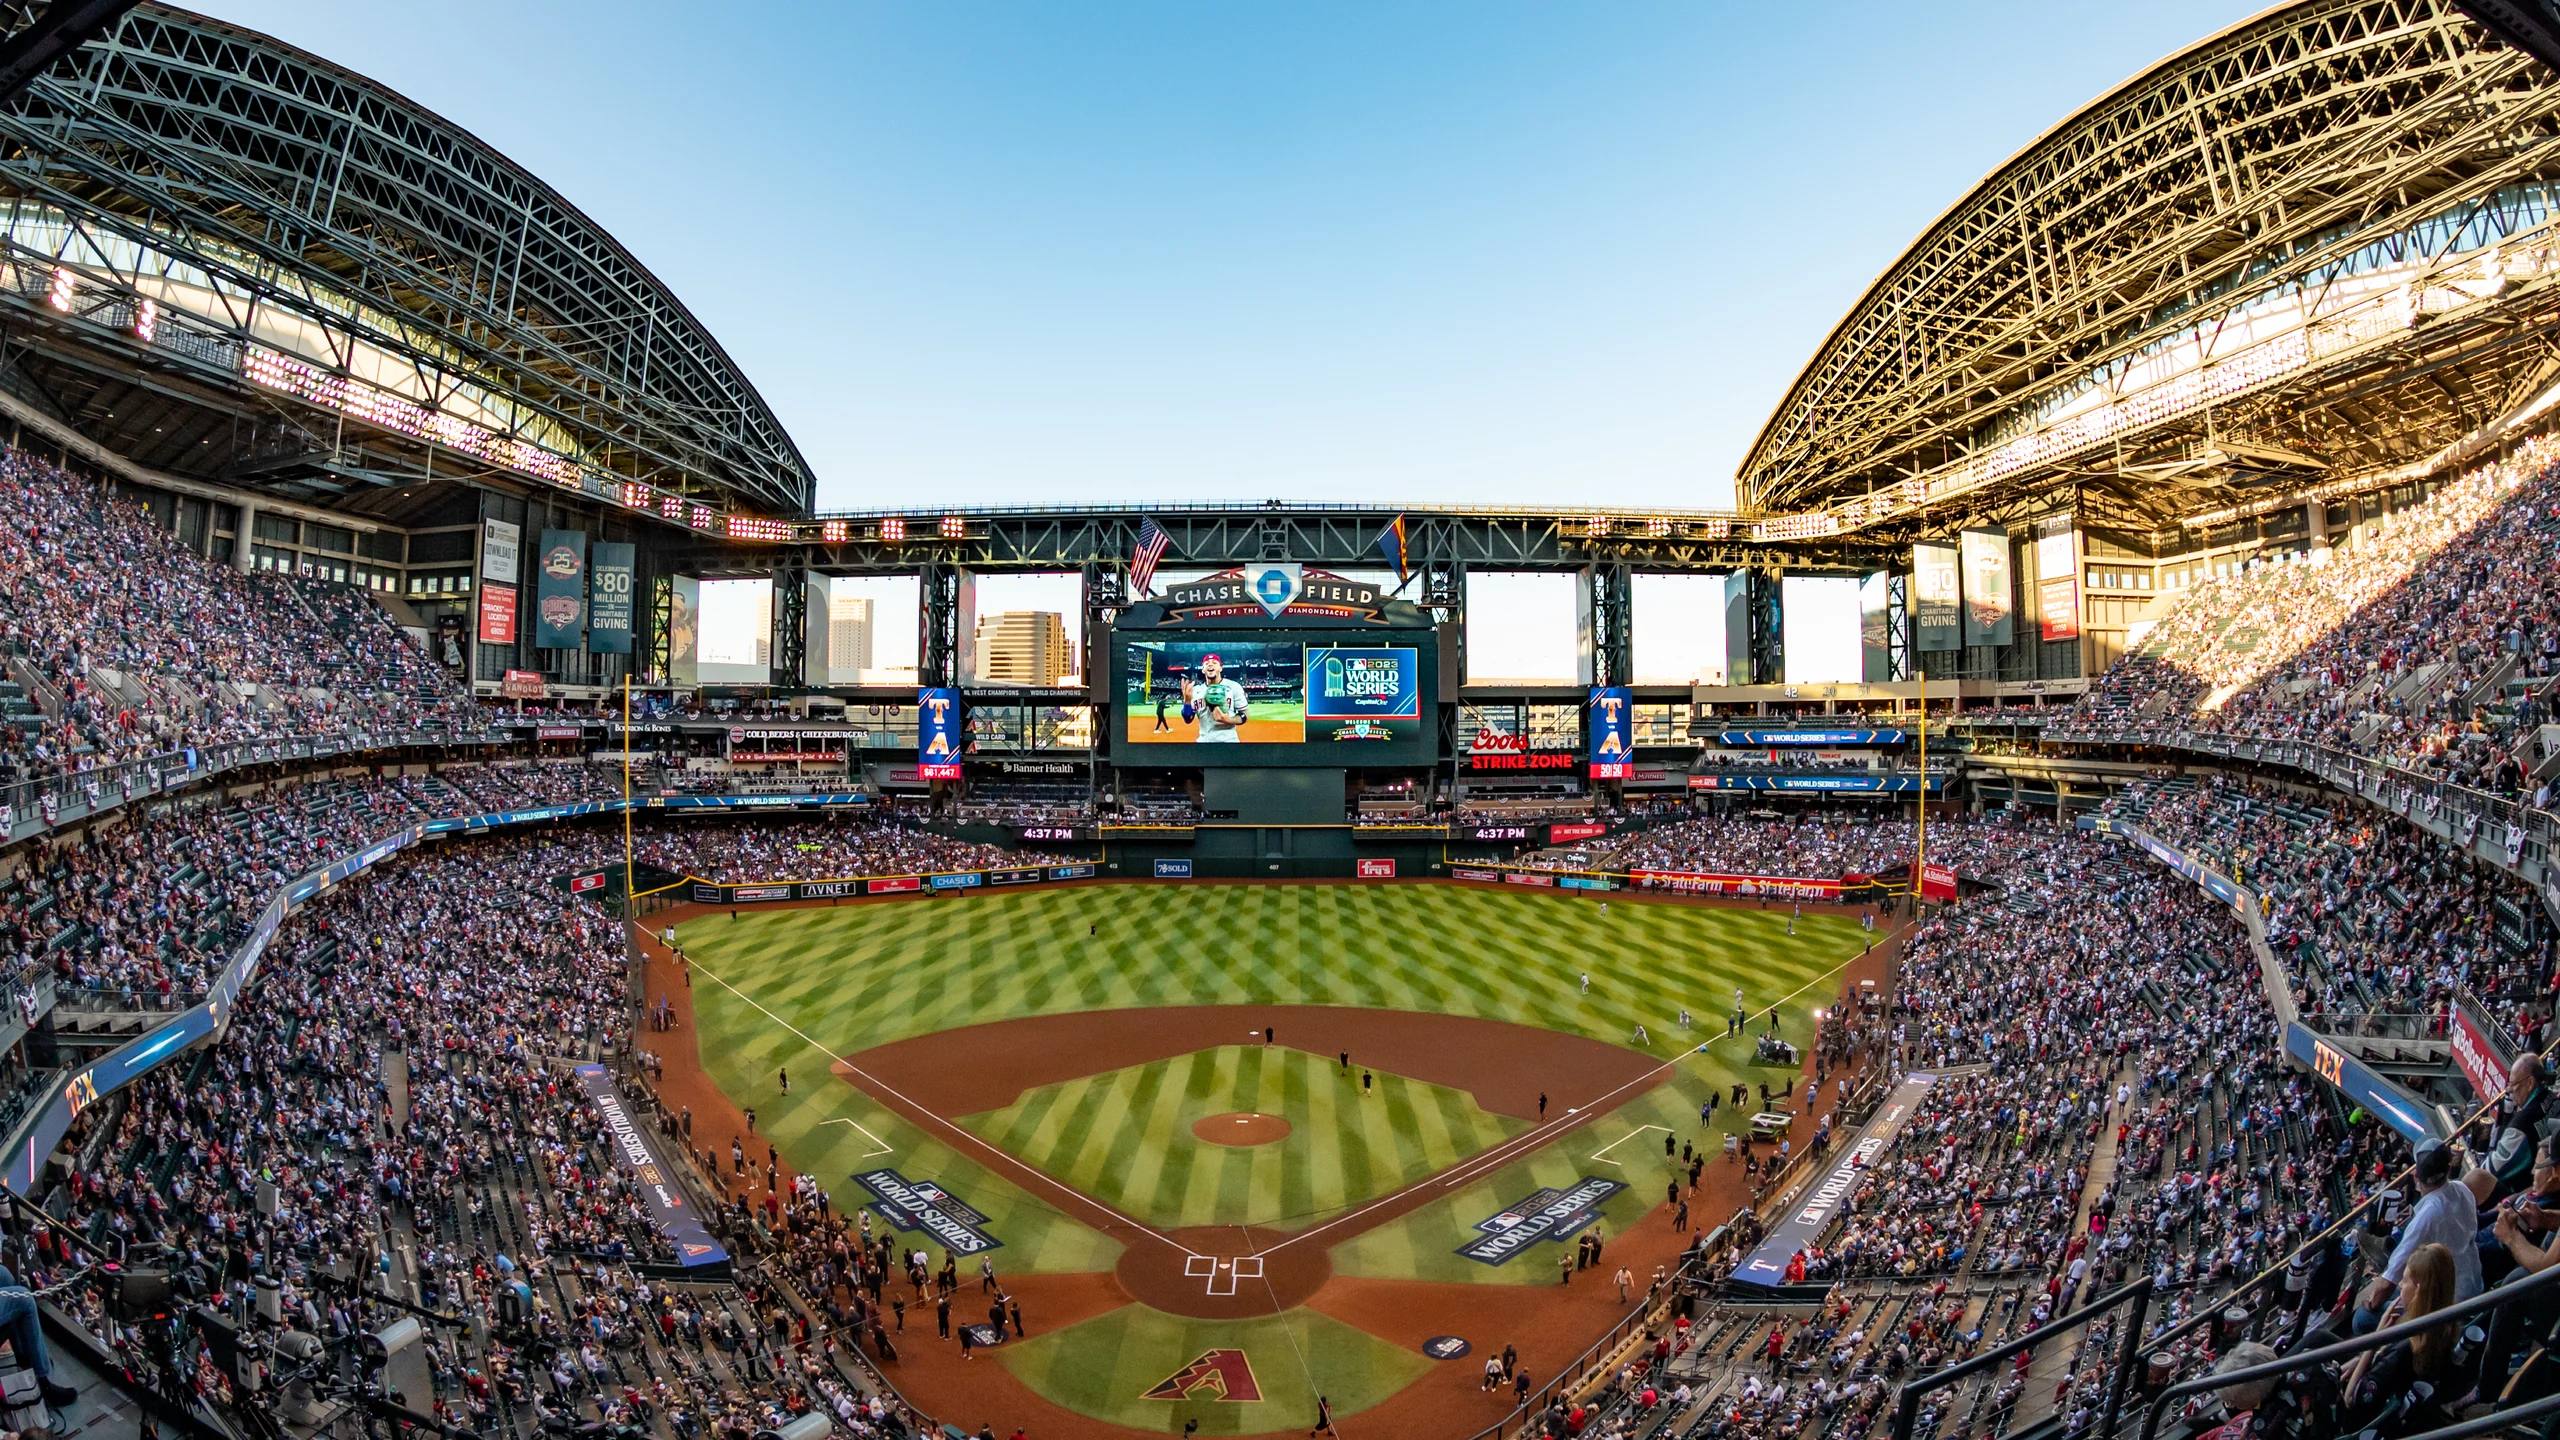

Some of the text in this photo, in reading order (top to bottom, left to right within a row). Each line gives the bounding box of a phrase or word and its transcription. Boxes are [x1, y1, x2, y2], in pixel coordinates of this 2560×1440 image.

[554, 553, 570, 568] 25
[596, 573, 630, 593] $80
[594, 594, 628, 603] MILLION
[1174, 586, 1373, 604] CHASE FIELD
[1288, 608, 1348, 617] DIAMONDBACKS
[594, 618, 628, 629] GIVING
[1922, 616, 1956, 626] GIVING
[1346, 670, 1398, 682] WORLD
[1346, 682, 1400, 694] SERIES
[1784, 687, 1798, 698] 42
[1822, 686, 1837, 696] 20
[928, 698, 950, 724] T
[1601, 698, 1622, 723] T
[746, 730, 768, 738] COLD
[768, 730, 794, 738] BEERS
[802, 730, 868, 738] CHEESEBURGERS
[1472, 728, 1578, 750] Coors LIGHT
[926, 732, 950, 754] A
[1598, 731, 1622, 754] A
[1013, 764, 1074, 772] Banner Health
[1472, 755, 1572, 768] STRIKE ZONE
[647, 798, 664, 806] ARI
[1024, 828, 1072, 839] 4:37 PM
[1476, 828, 1525, 838] 4:37 PM
[2095, 820, 2111, 832] TEX
[1362, 861, 1391, 876] fry's
[937, 876, 967, 886] CHASE
[2460, 1028, 2486, 1081] Ballpark
[2313, 1040, 2345, 1087] TEX
[64, 1069, 99, 1118] TEX
[603, 1103, 627, 1138] WORLD
[618, 1132, 653, 1166] SERIES
[1808, 1164, 1856, 1208] WORLD
[1514, 1191, 1560, 1216] 2023
[866, 1172, 987, 1252] WORLD SERIES
[938, 1200, 978, 1224] 2023
[1470, 1180, 1614, 1258] WORLD SERIES
